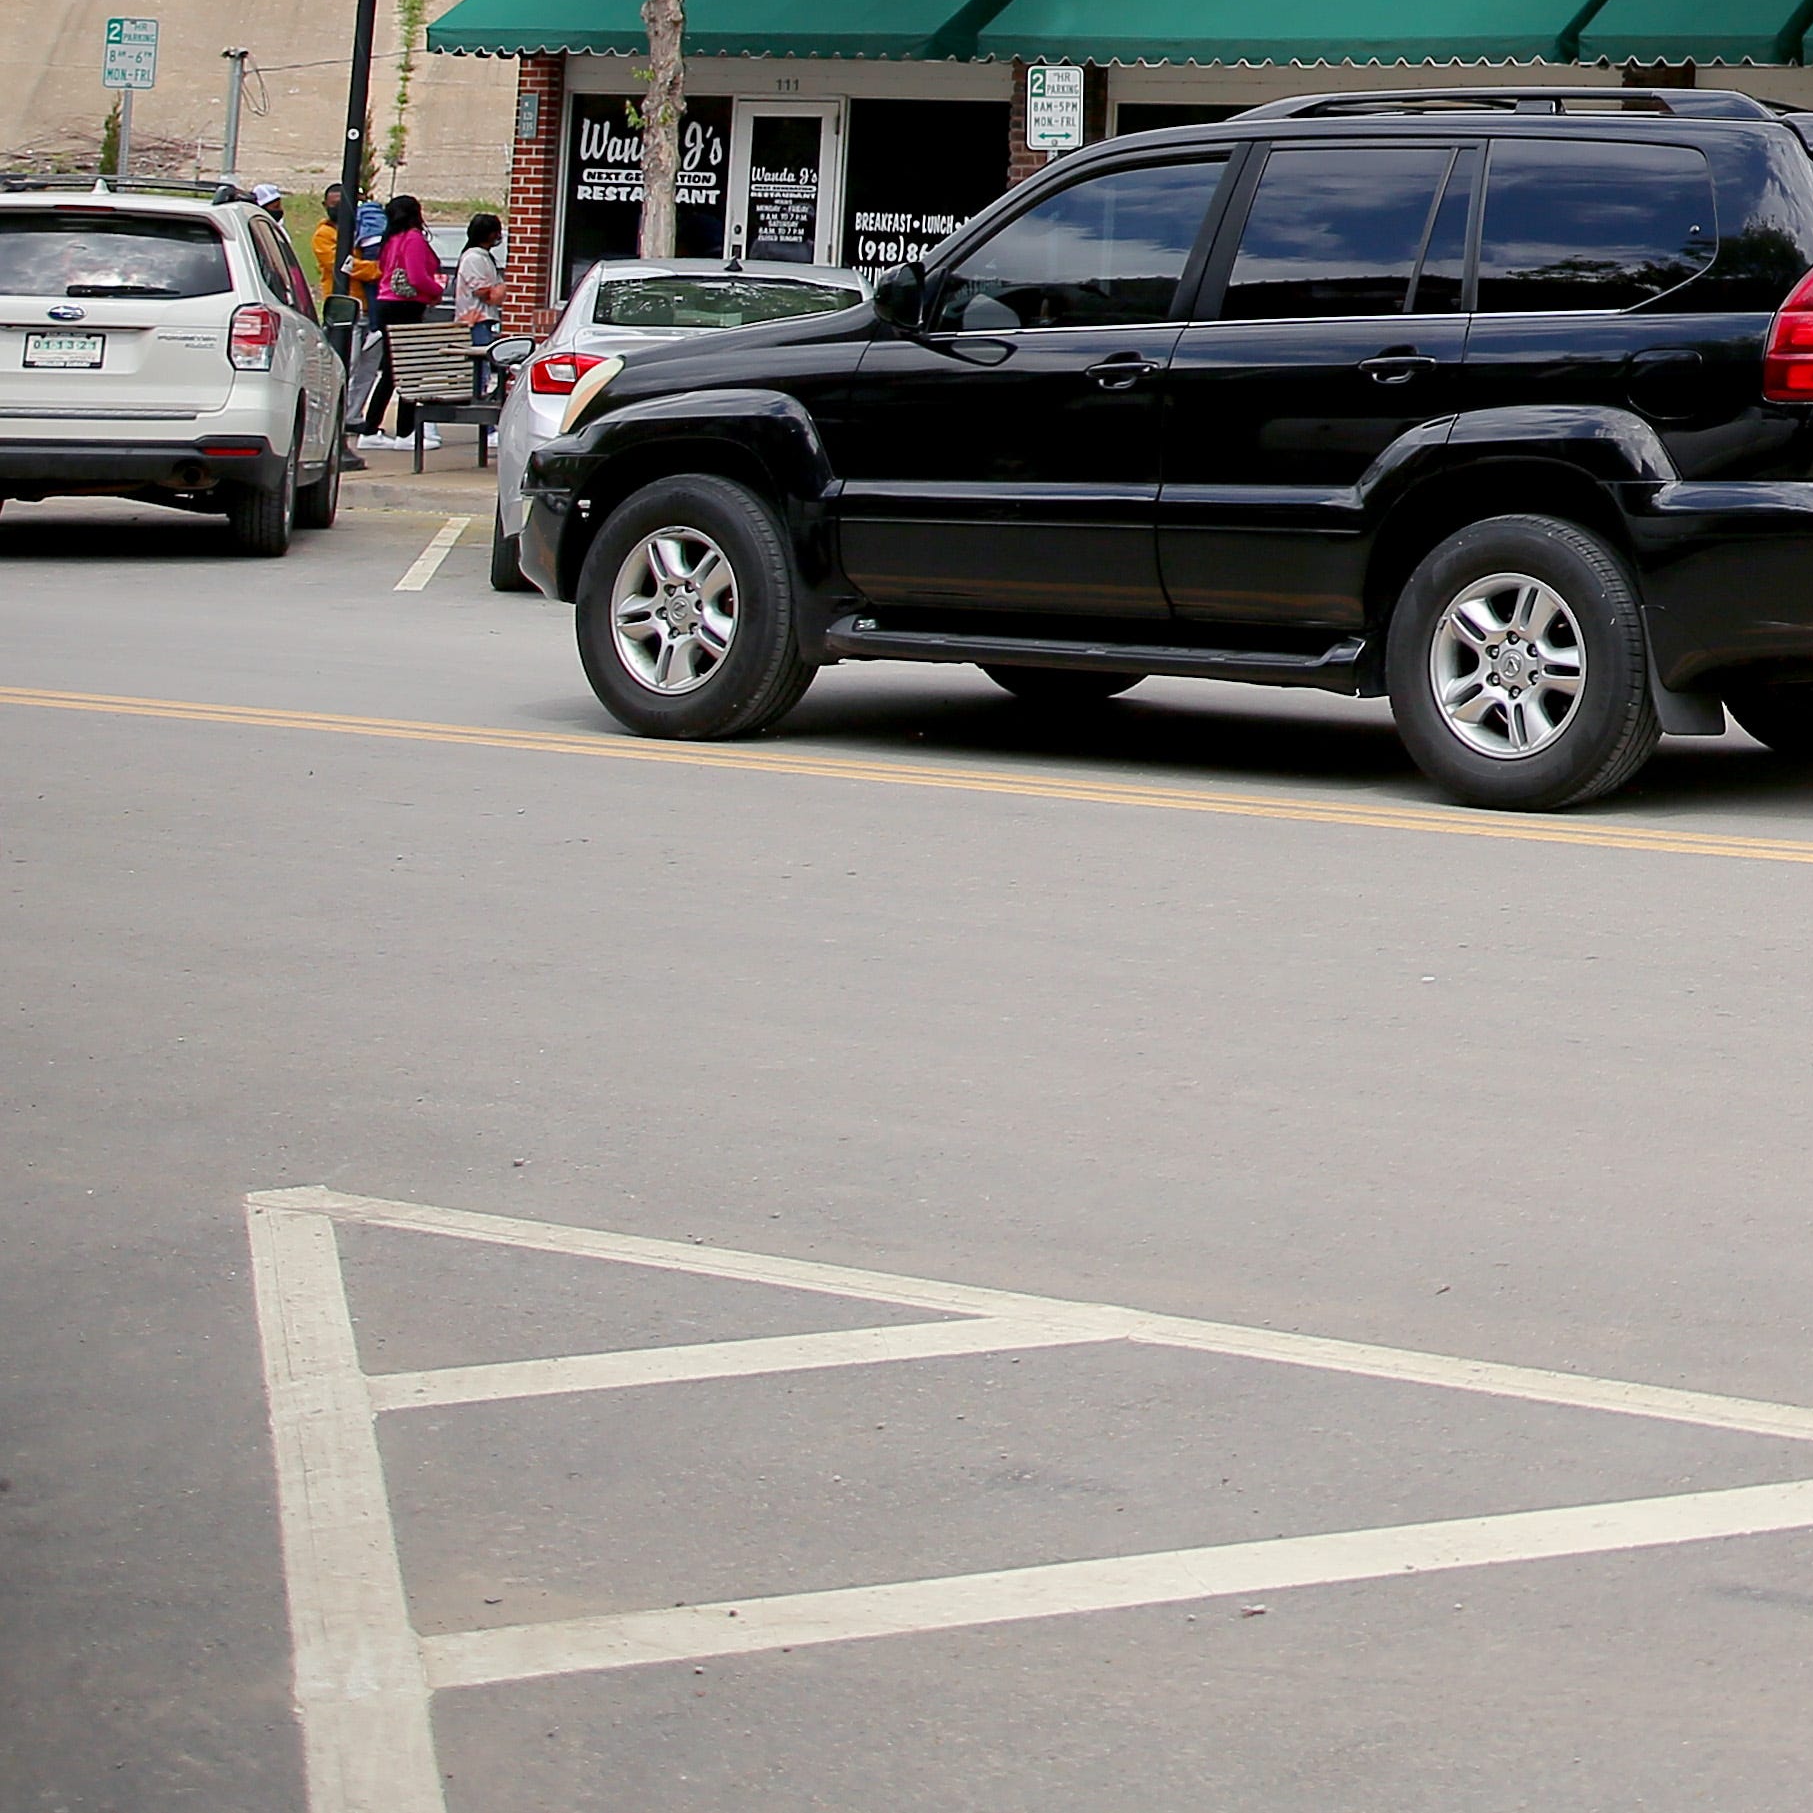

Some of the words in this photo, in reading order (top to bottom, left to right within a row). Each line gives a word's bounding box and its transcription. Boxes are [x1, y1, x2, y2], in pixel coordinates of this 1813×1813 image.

[109, 23, 121, 40] 2
[123, 34, 156, 43] PARKING
[776, 78, 800, 90] 111
[1032, 73, 1044, 93] 2
[1056, 72, 1071, 82] HR
[1046, 84, 1079, 94] PARKING
[683, 121, 722, 171] J's
[586, 171, 621, 182] NEXT
[751, 166, 796, 183] Wanda
[799, 167, 818, 185] J's
[855, 212, 912, 233] BREAKFAST
[922, 214, 954, 234] LUNCH
